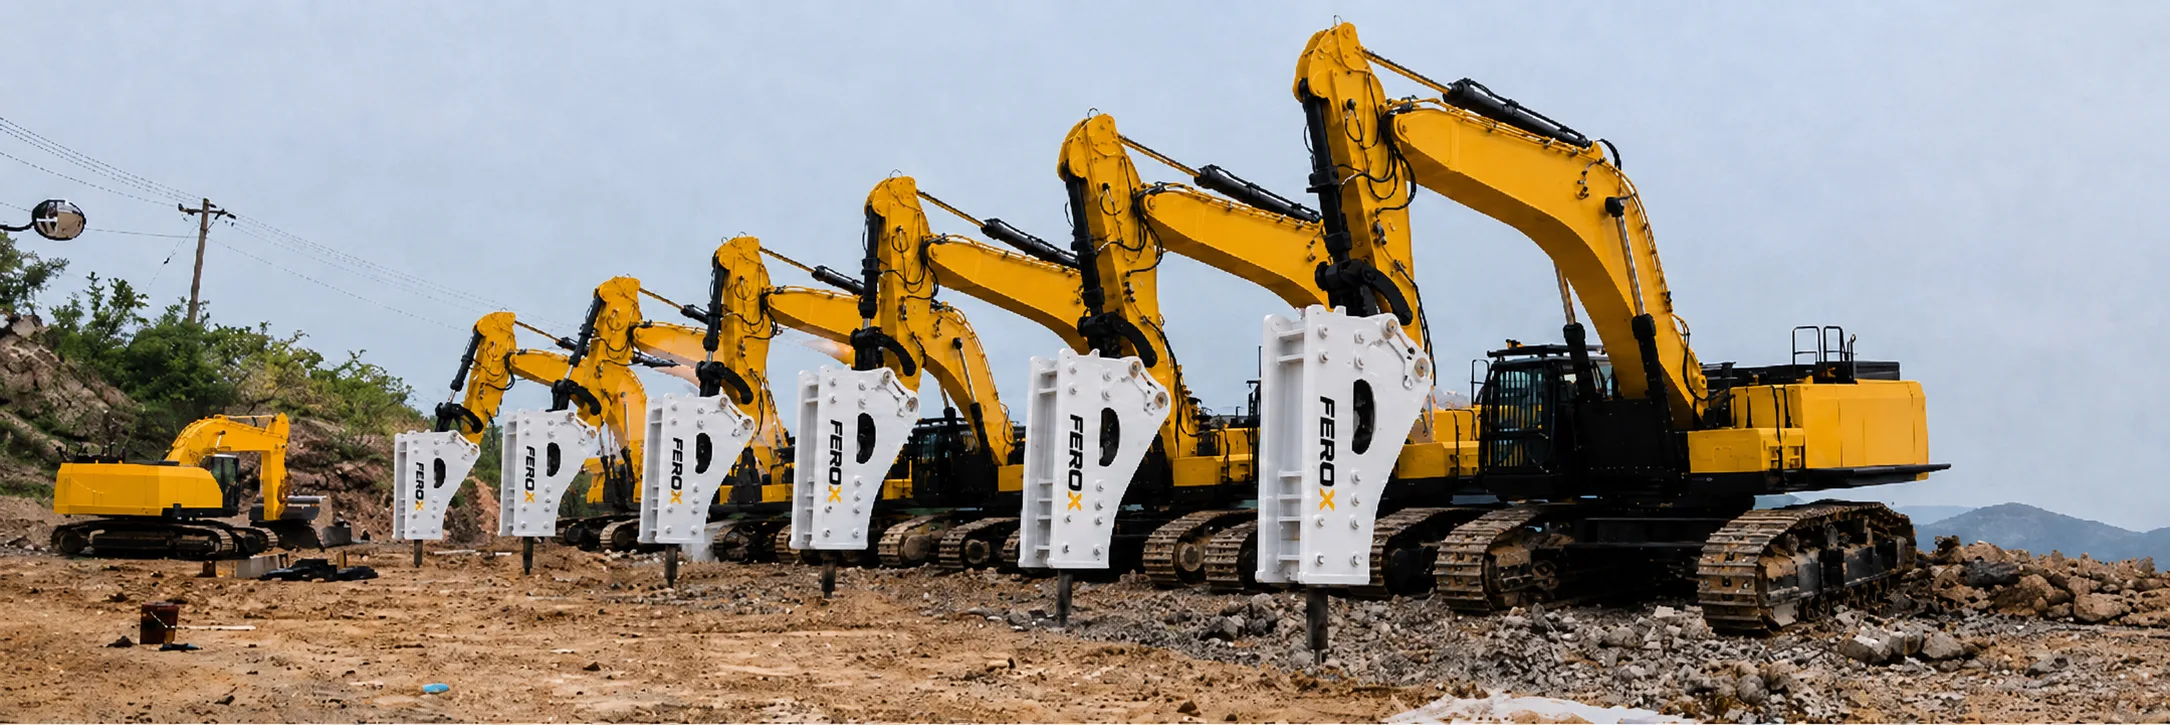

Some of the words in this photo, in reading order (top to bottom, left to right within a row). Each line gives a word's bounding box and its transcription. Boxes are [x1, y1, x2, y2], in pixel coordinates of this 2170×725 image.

[415, 461, 425, 511] FEROX
[525, 446, 536, 503] FEROX
[671, 437, 683, 505] FEROX
[828, 419, 843, 503] FEROX
[1068, 414, 1084, 511] FEROX
[1319, 395, 1336, 511] FEROX
